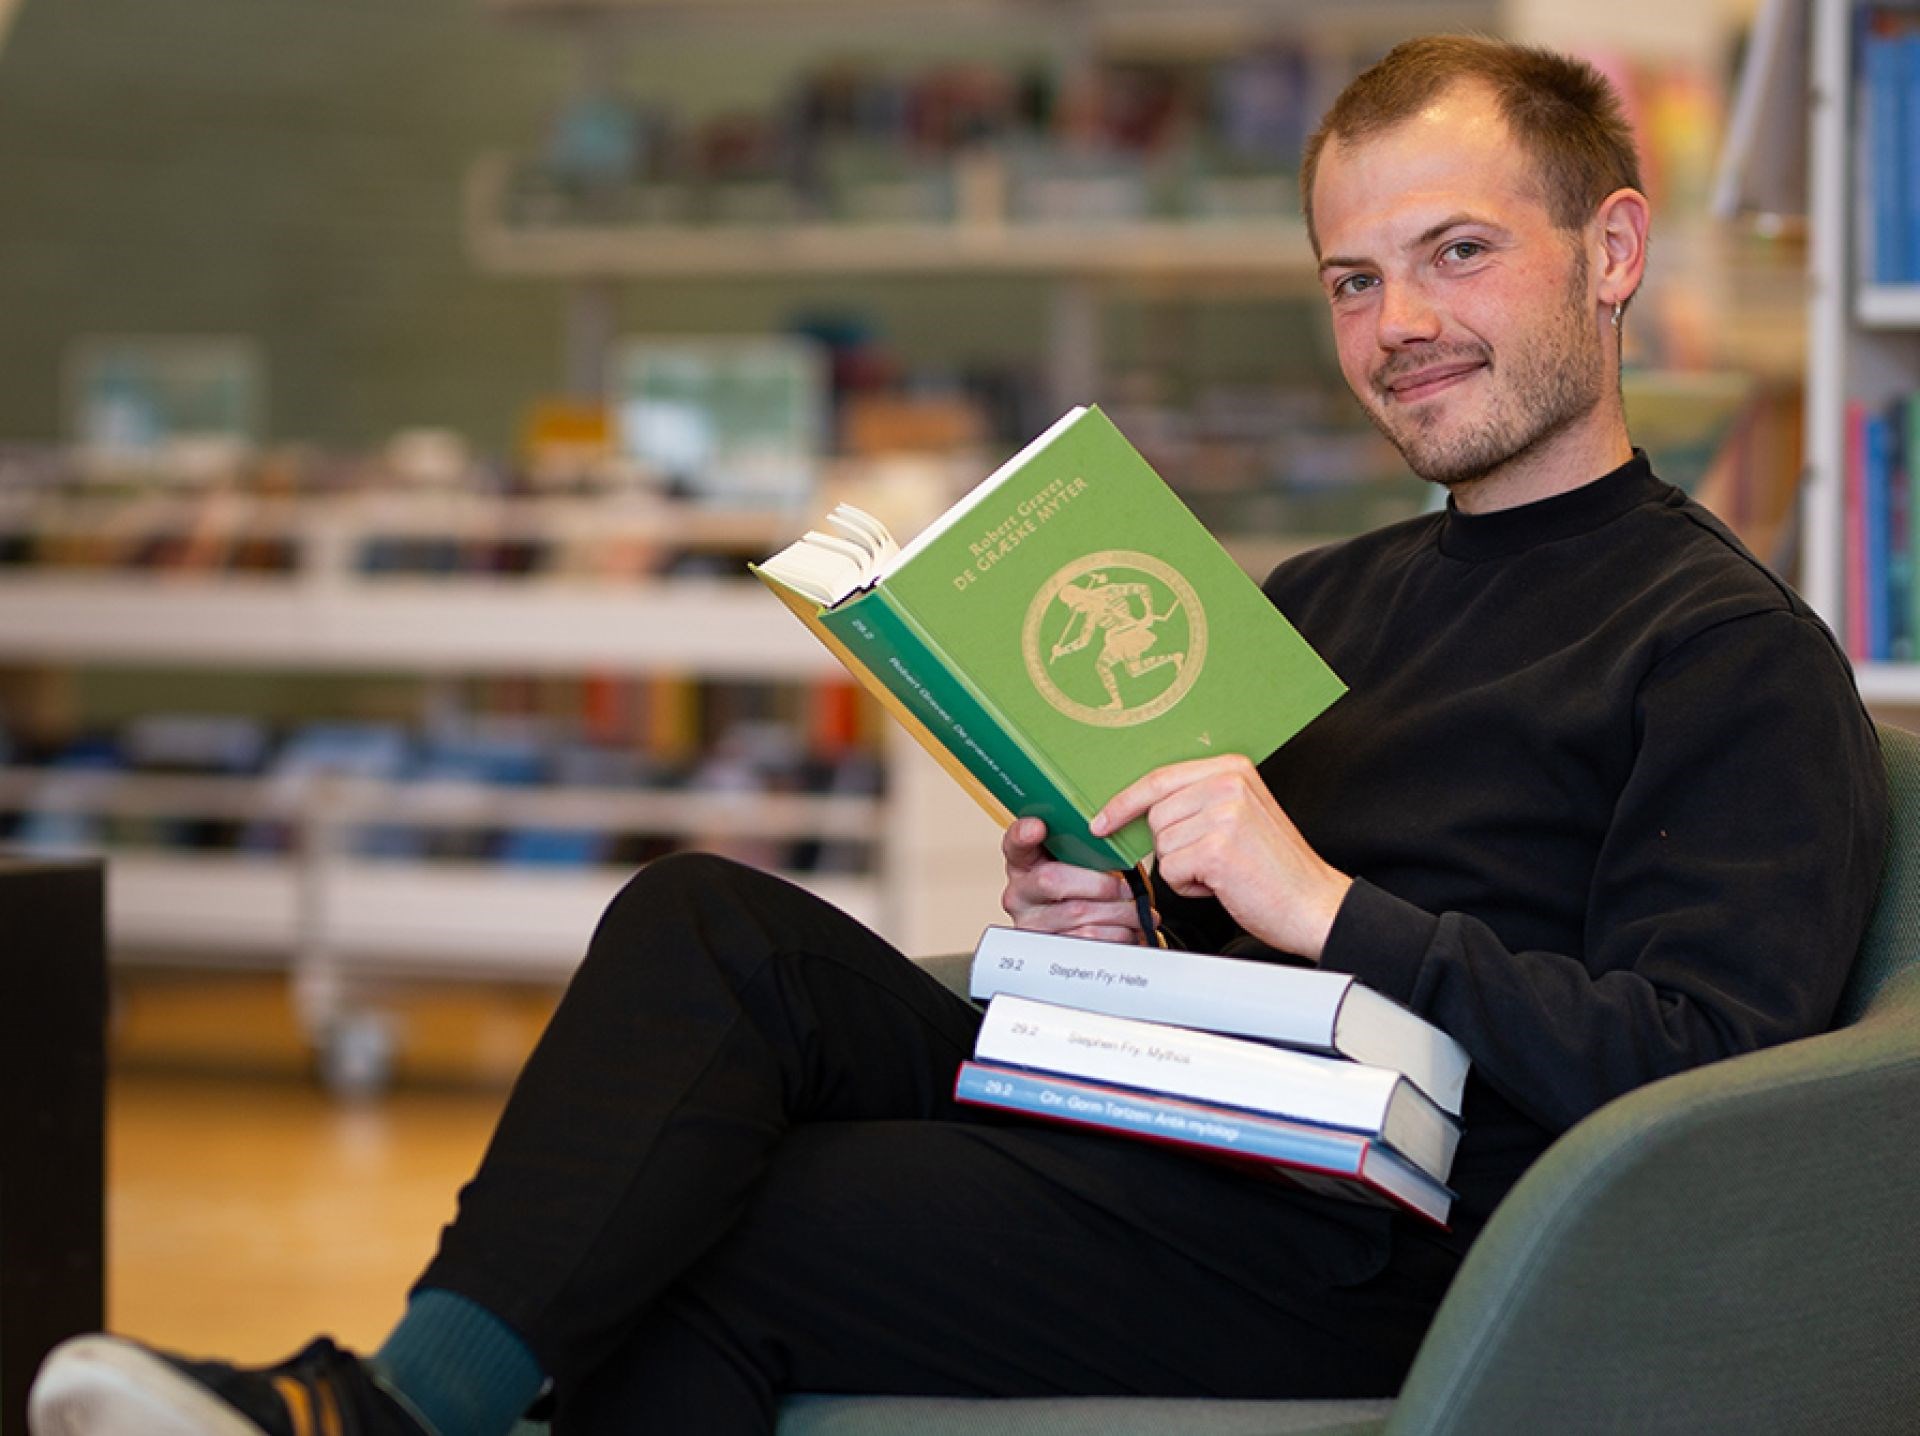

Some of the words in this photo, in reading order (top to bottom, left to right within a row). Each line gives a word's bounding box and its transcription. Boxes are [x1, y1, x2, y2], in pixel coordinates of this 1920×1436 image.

[953, 569, 977, 591] DE
[976, 519, 1037, 571] GRÆSKE
[1037, 477, 1088, 523] MYTER
[969, 516, 1018, 556] Robert
[1017, 478, 1063, 517] Graves
[998, 956, 1025, 972] 29.2
[1049, 962, 1095, 980] Stephen
[985, 1080, 1013, 1096] 29.2
